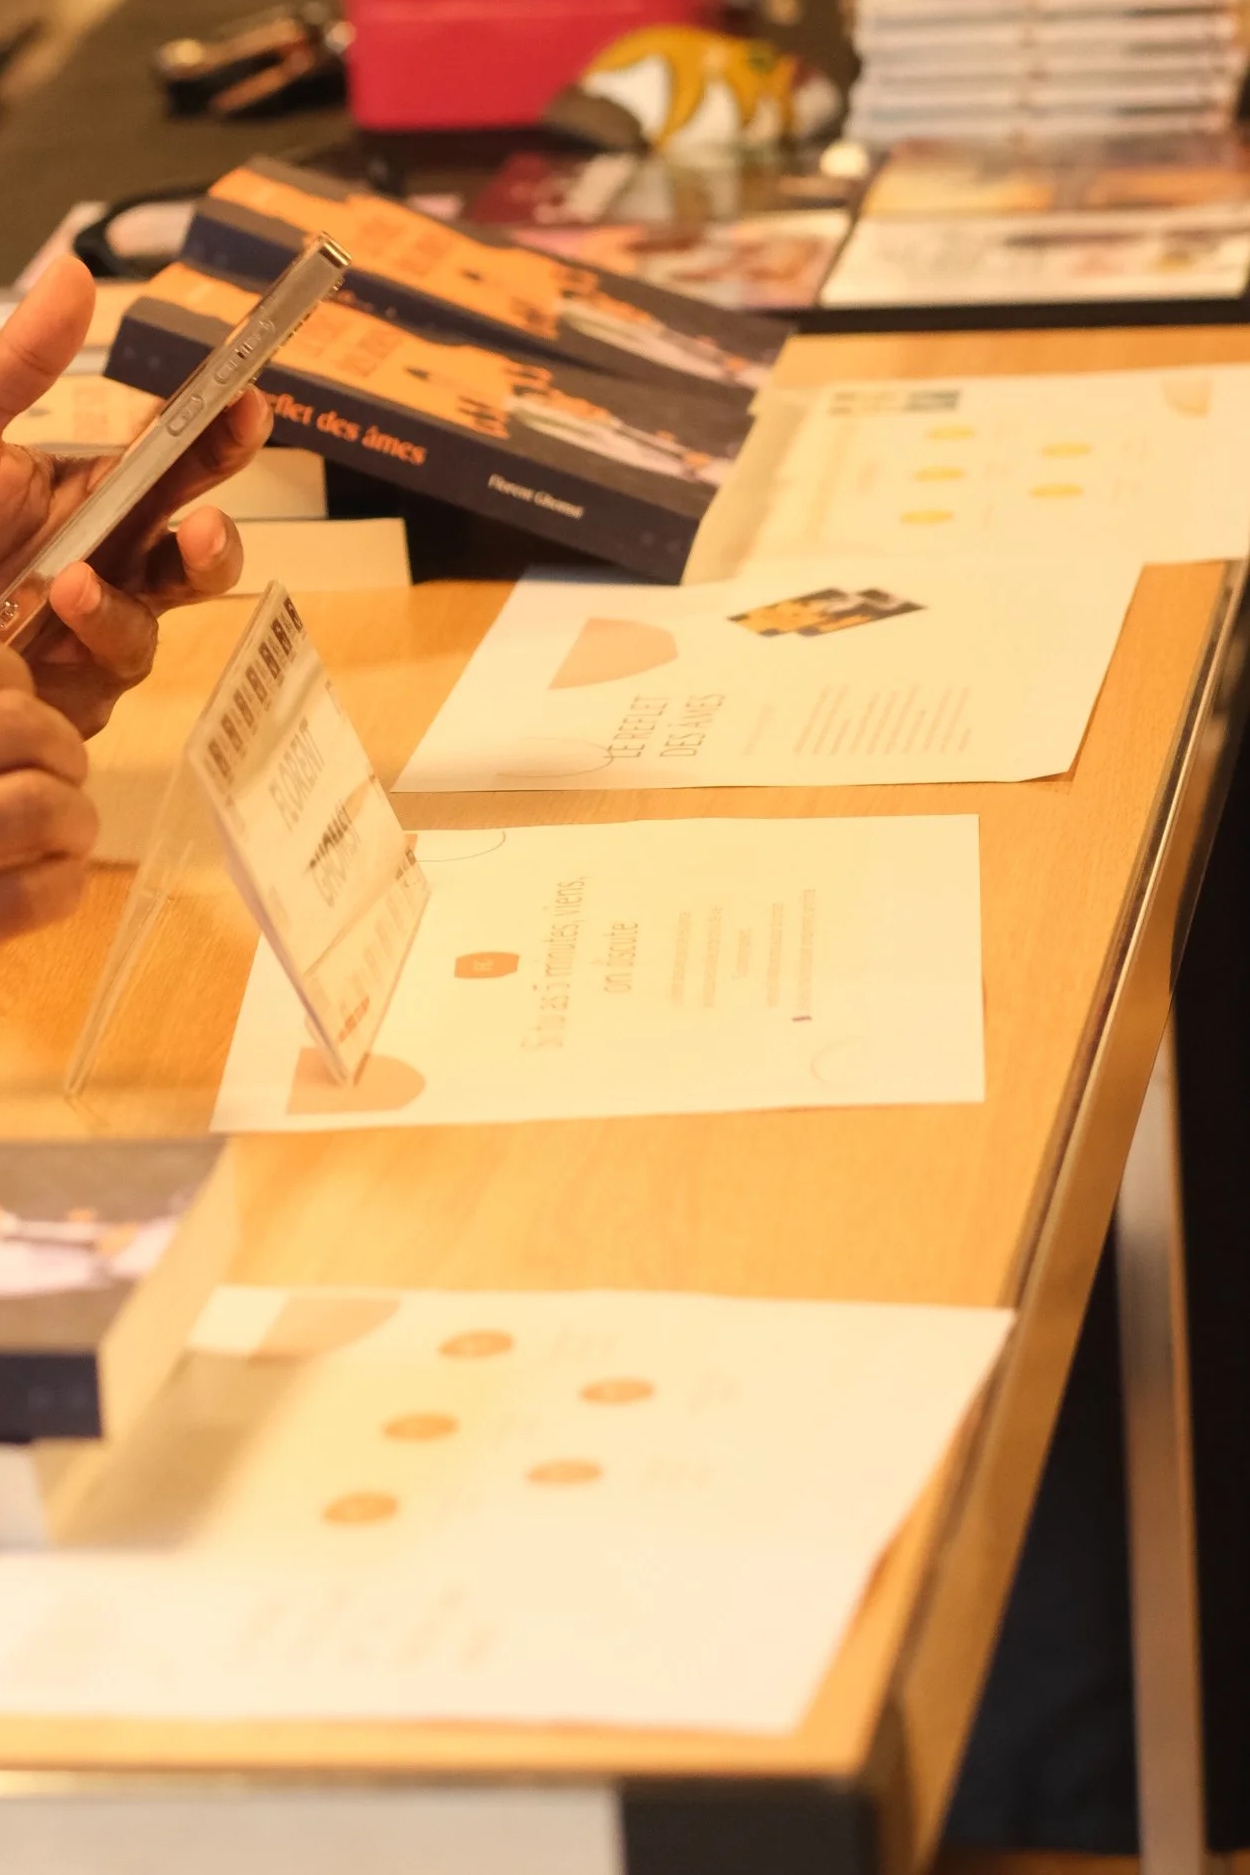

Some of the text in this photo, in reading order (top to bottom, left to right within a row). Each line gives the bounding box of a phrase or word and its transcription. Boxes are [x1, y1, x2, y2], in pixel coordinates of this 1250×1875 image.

[316, 409, 362, 443] des
[361, 424, 428, 466] âmes
[603, 693, 671, 759] LE REFLET
[659, 732, 707, 757] DES
[267, 713, 326, 834] FLORENT
[603, 974, 635, 994] on
